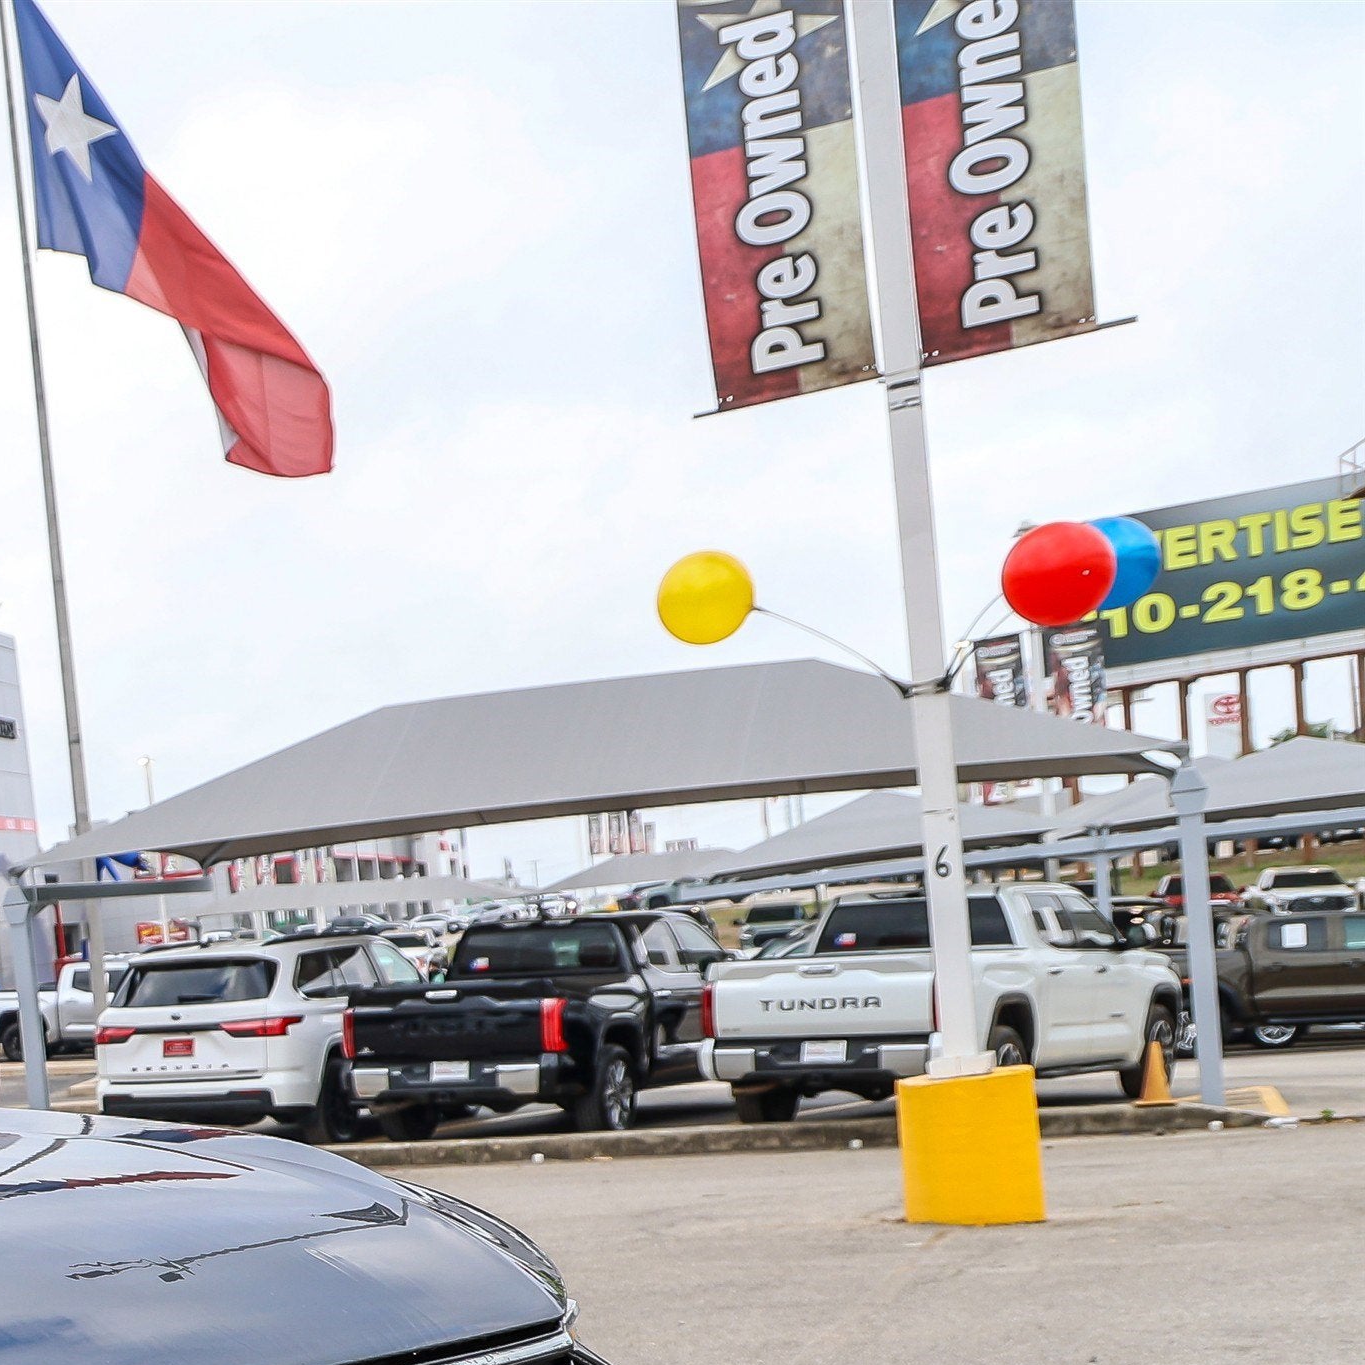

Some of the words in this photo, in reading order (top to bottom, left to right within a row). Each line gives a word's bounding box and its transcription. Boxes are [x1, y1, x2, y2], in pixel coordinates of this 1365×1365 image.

[719, 10, 812, 246] Owned
[960, 202, 1041, 328] Pre
[752, 253, 825, 374] Pre
[1153, 498, 1363, 571] ERTISE
[1080, 566, 1365, 639] 10-218-
[935, 844, 952, 877] 6
[759, 996, 882, 1012] TUNDRA
